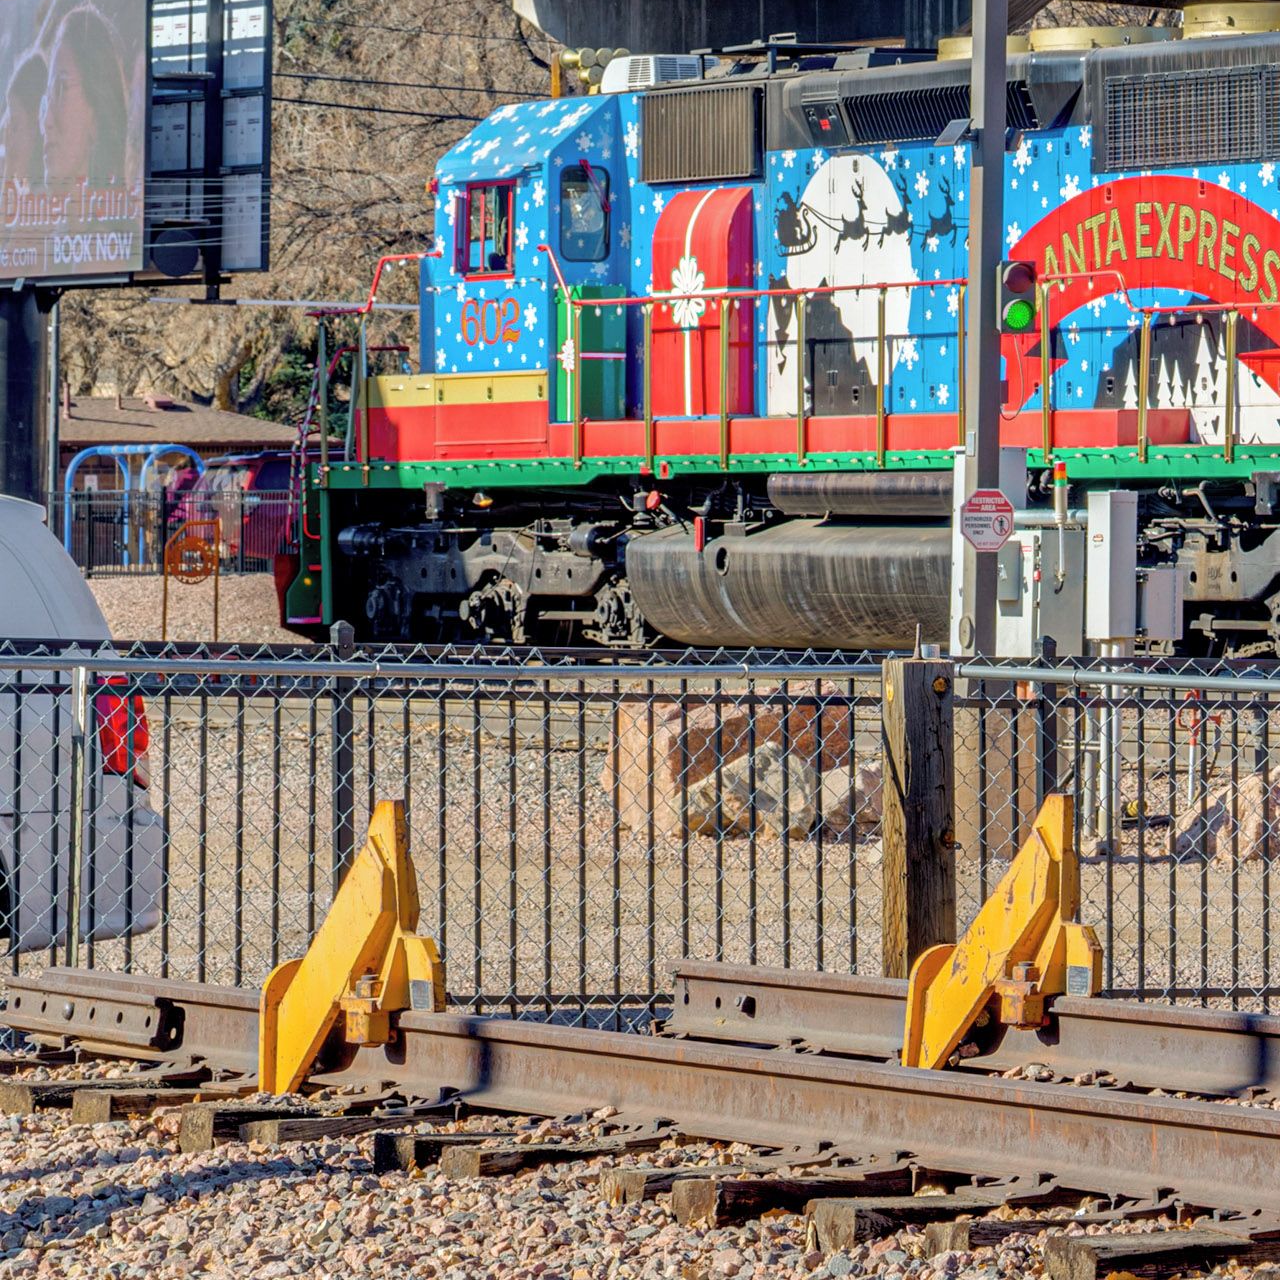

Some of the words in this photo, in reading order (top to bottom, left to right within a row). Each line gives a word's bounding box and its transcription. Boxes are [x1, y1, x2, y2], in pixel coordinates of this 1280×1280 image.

[4, 176, 71, 227] Dinner
[76, 174, 141, 222] Trains
[0, 246, 37, 267] e.com
[53, 233, 92, 264] BOOK
[96, 231, 133, 261] NOW
[1036, 207, 1128, 310] ANTA
[460, 297, 521, 346] 602
